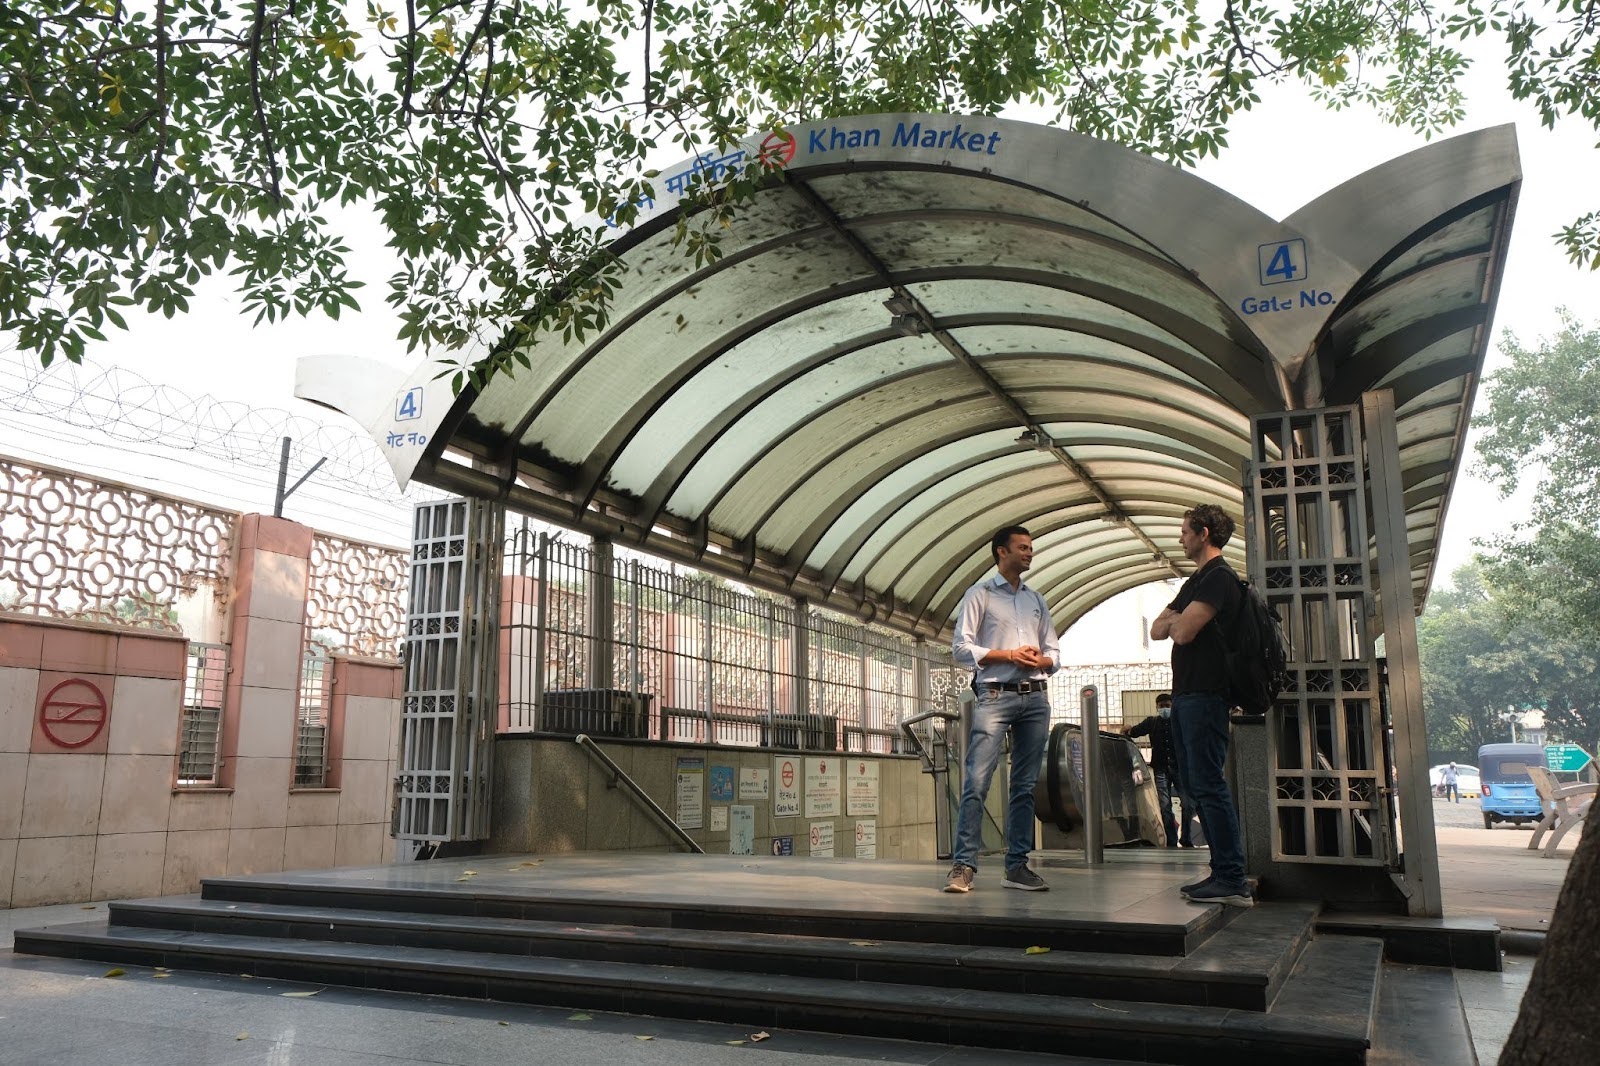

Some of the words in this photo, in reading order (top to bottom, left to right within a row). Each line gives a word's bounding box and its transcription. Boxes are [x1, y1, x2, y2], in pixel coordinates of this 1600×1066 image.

[808, 128, 880, 154] Khan
[891, 122, 1001, 155] Market
[1266, 245, 1297, 279] 4
[1241, 296, 1293, 316] Gate
[1300, 290, 1336, 308] No.
[400, 392, 416, 417] 4
[386, 431, 405, 448] गेट
[777, 804, 787, 813] Gate
